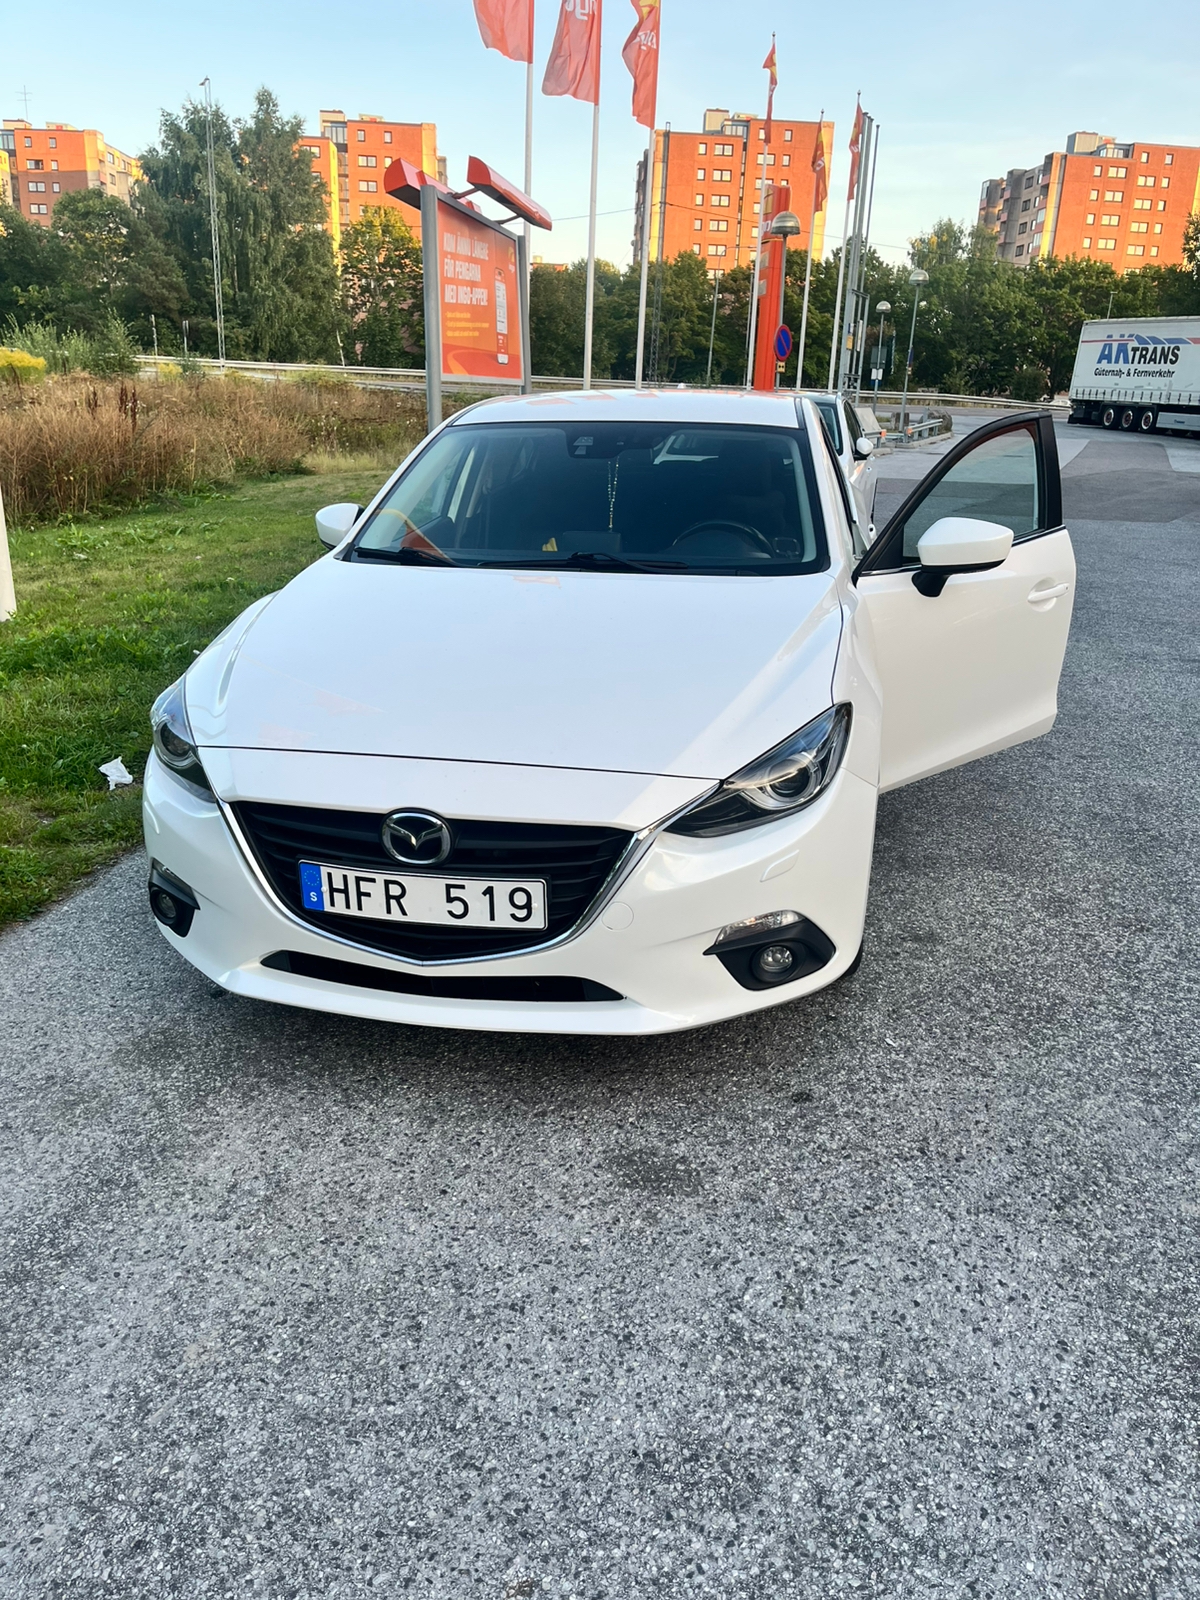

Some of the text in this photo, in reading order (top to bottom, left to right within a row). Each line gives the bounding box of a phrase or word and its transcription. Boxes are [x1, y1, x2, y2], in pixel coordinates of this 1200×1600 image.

[444, 254, 455, 278] FÖR
[455, 260, 481, 282] PENGARNA
[444, 284, 457, 304] MED
[1126, 368, 1131, 377] &
[1133, 368, 1175, 378] Fernverkehr
[309, 891, 319, 902] S
[326, 871, 534, 923] HFR 519
